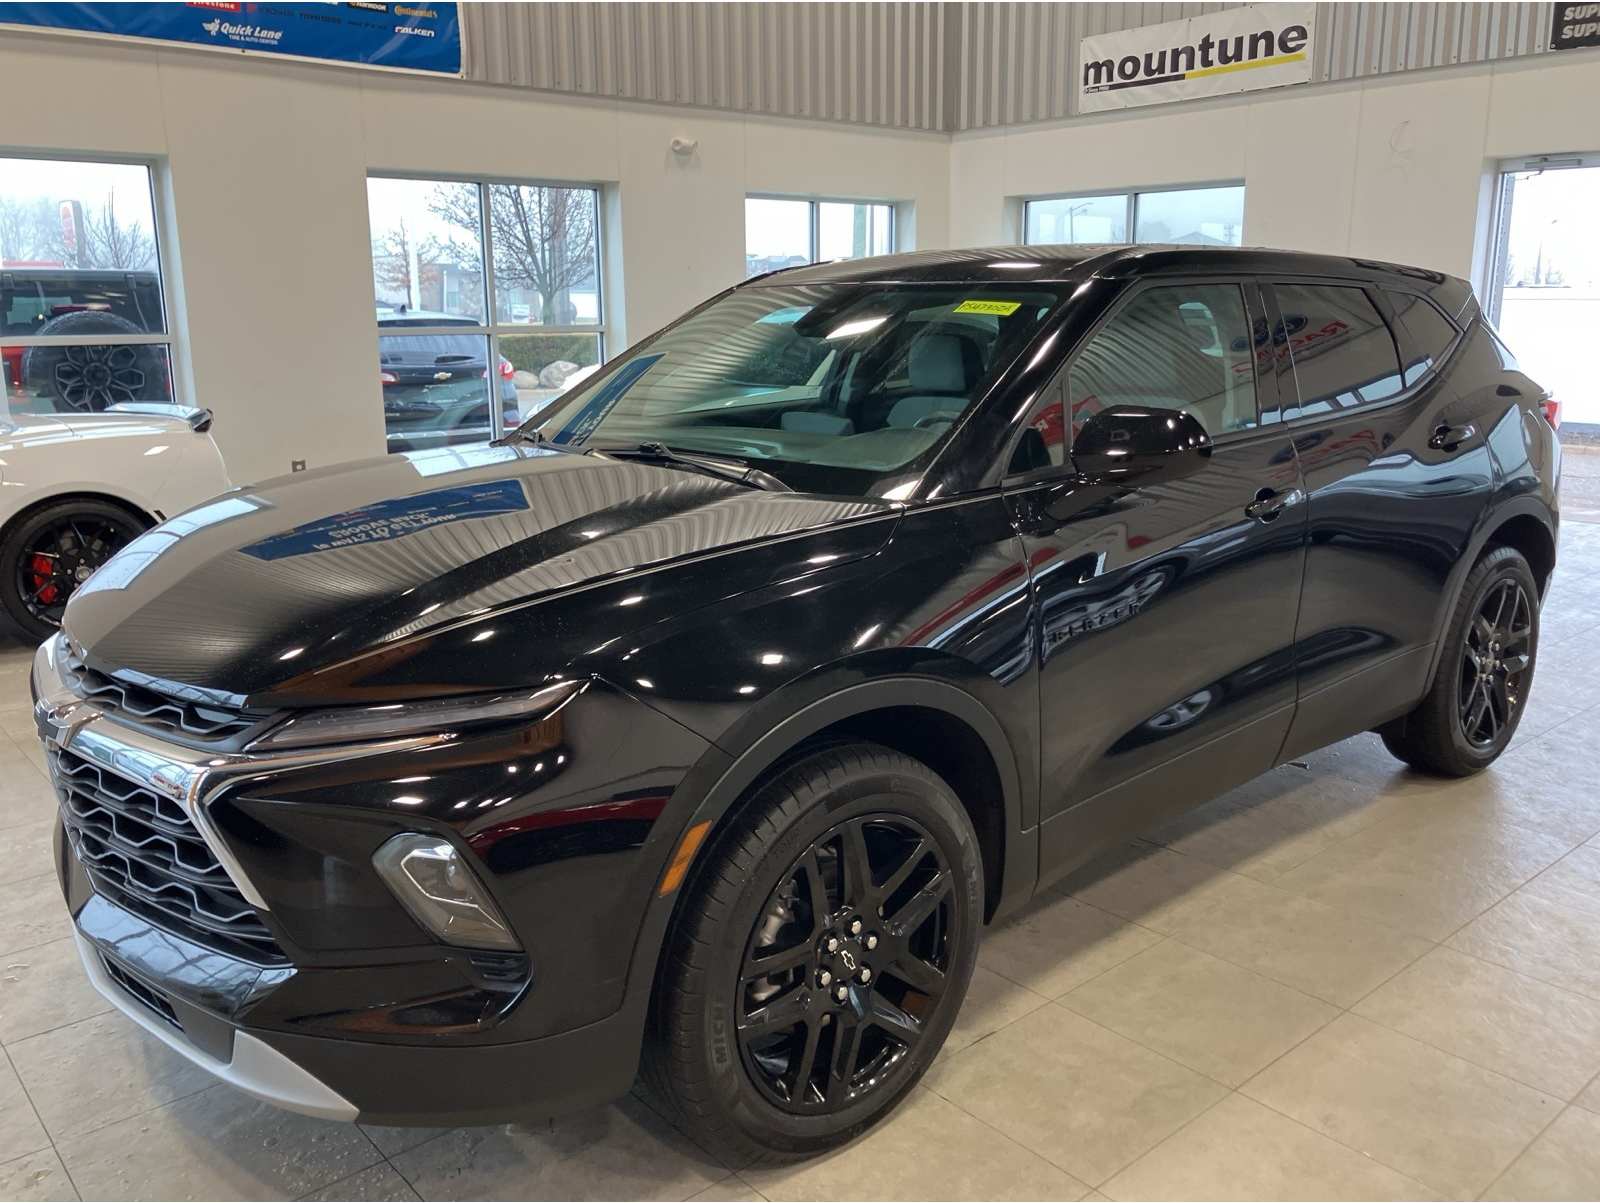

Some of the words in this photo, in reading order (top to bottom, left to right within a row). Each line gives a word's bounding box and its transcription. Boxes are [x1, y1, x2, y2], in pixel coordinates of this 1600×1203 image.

[1563, 4, 1600, 21] SUP
[221, 22, 254, 36] Quick
[254, 26, 282, 40] Lane
[1561, 22, 1600, 39] SUP
[1083, 25, 1309, 87] mountune
